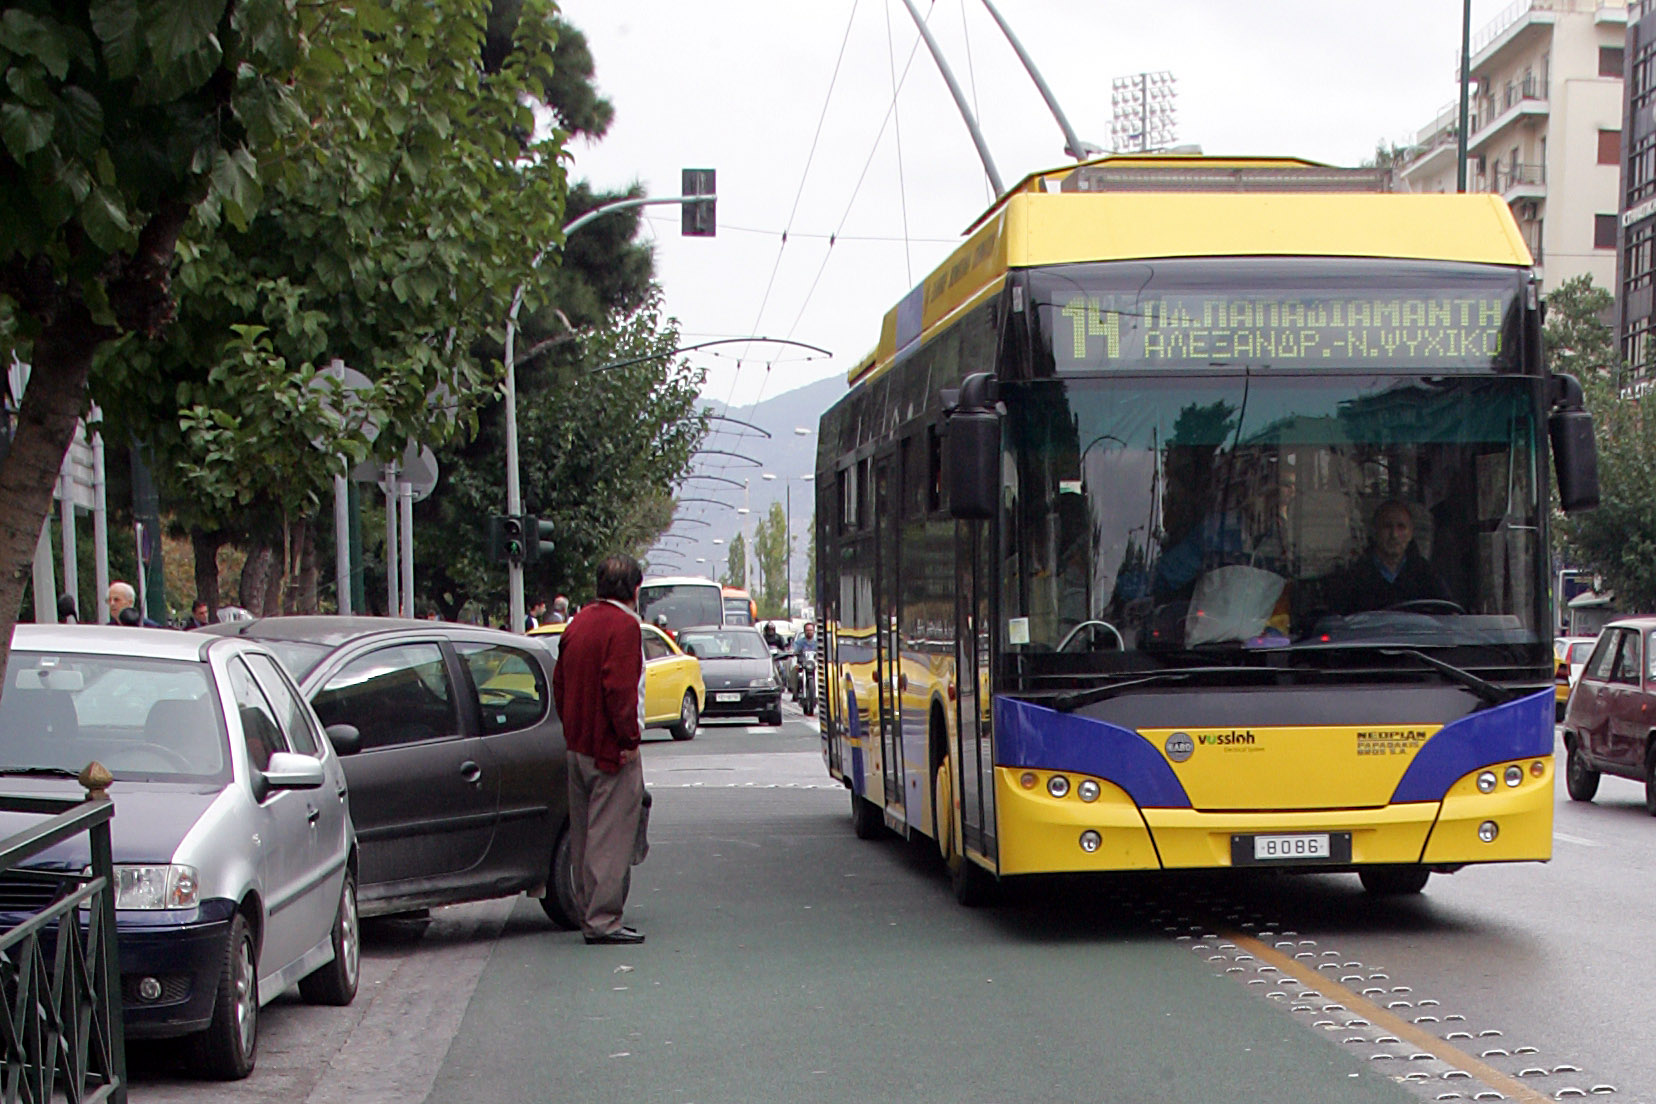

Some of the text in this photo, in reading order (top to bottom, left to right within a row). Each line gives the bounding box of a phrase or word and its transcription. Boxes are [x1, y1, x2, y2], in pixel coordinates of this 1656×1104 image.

[1062, 298, 1119, 358] 14
[1357, 731, 1426, 741] NEOPLAN
[1267, 839, 1318, 855] 8086
